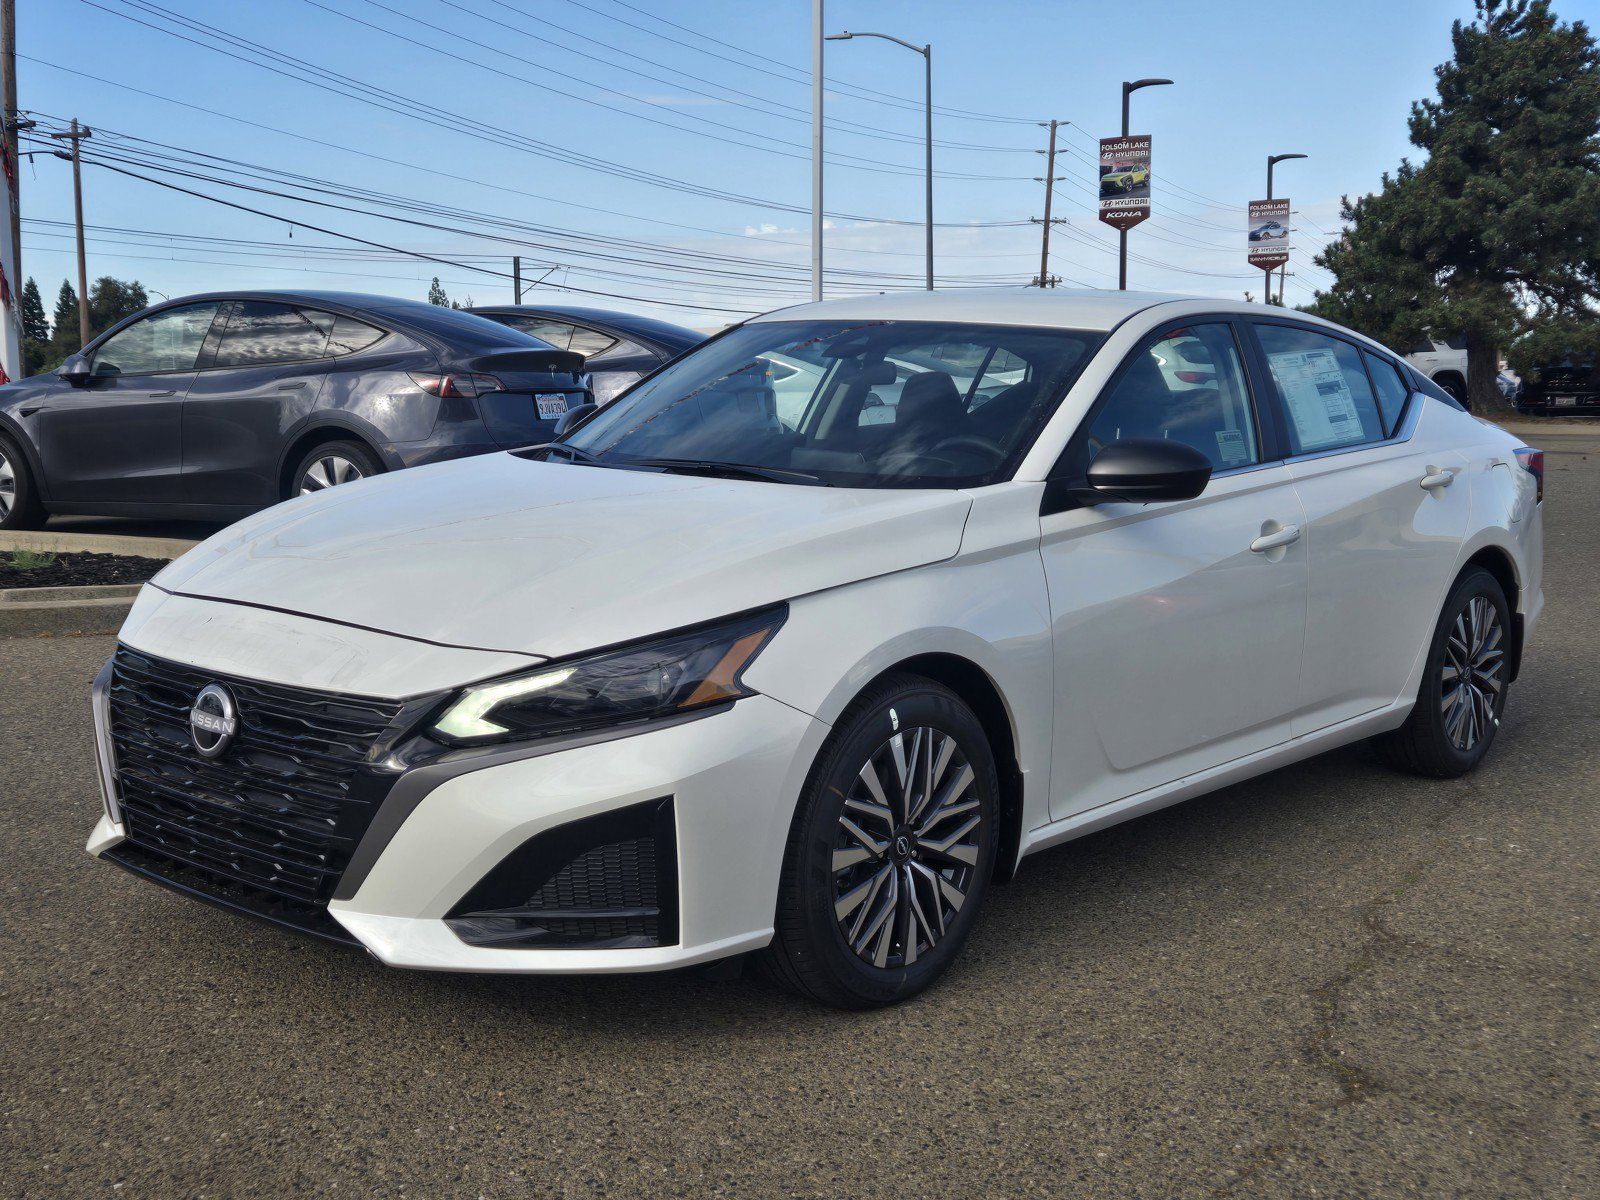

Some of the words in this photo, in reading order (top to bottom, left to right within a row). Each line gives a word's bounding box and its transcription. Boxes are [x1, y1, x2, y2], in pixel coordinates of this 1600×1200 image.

[1102, 143, 1129, 151] FOLSOM
[1131, 141, 1149, 149] LAKE
[1116, 150, 1148, 158] HYUNDAI
[1106, 211, 1142, 219] KONA
[190, 708, 233, 733] NISSAN
